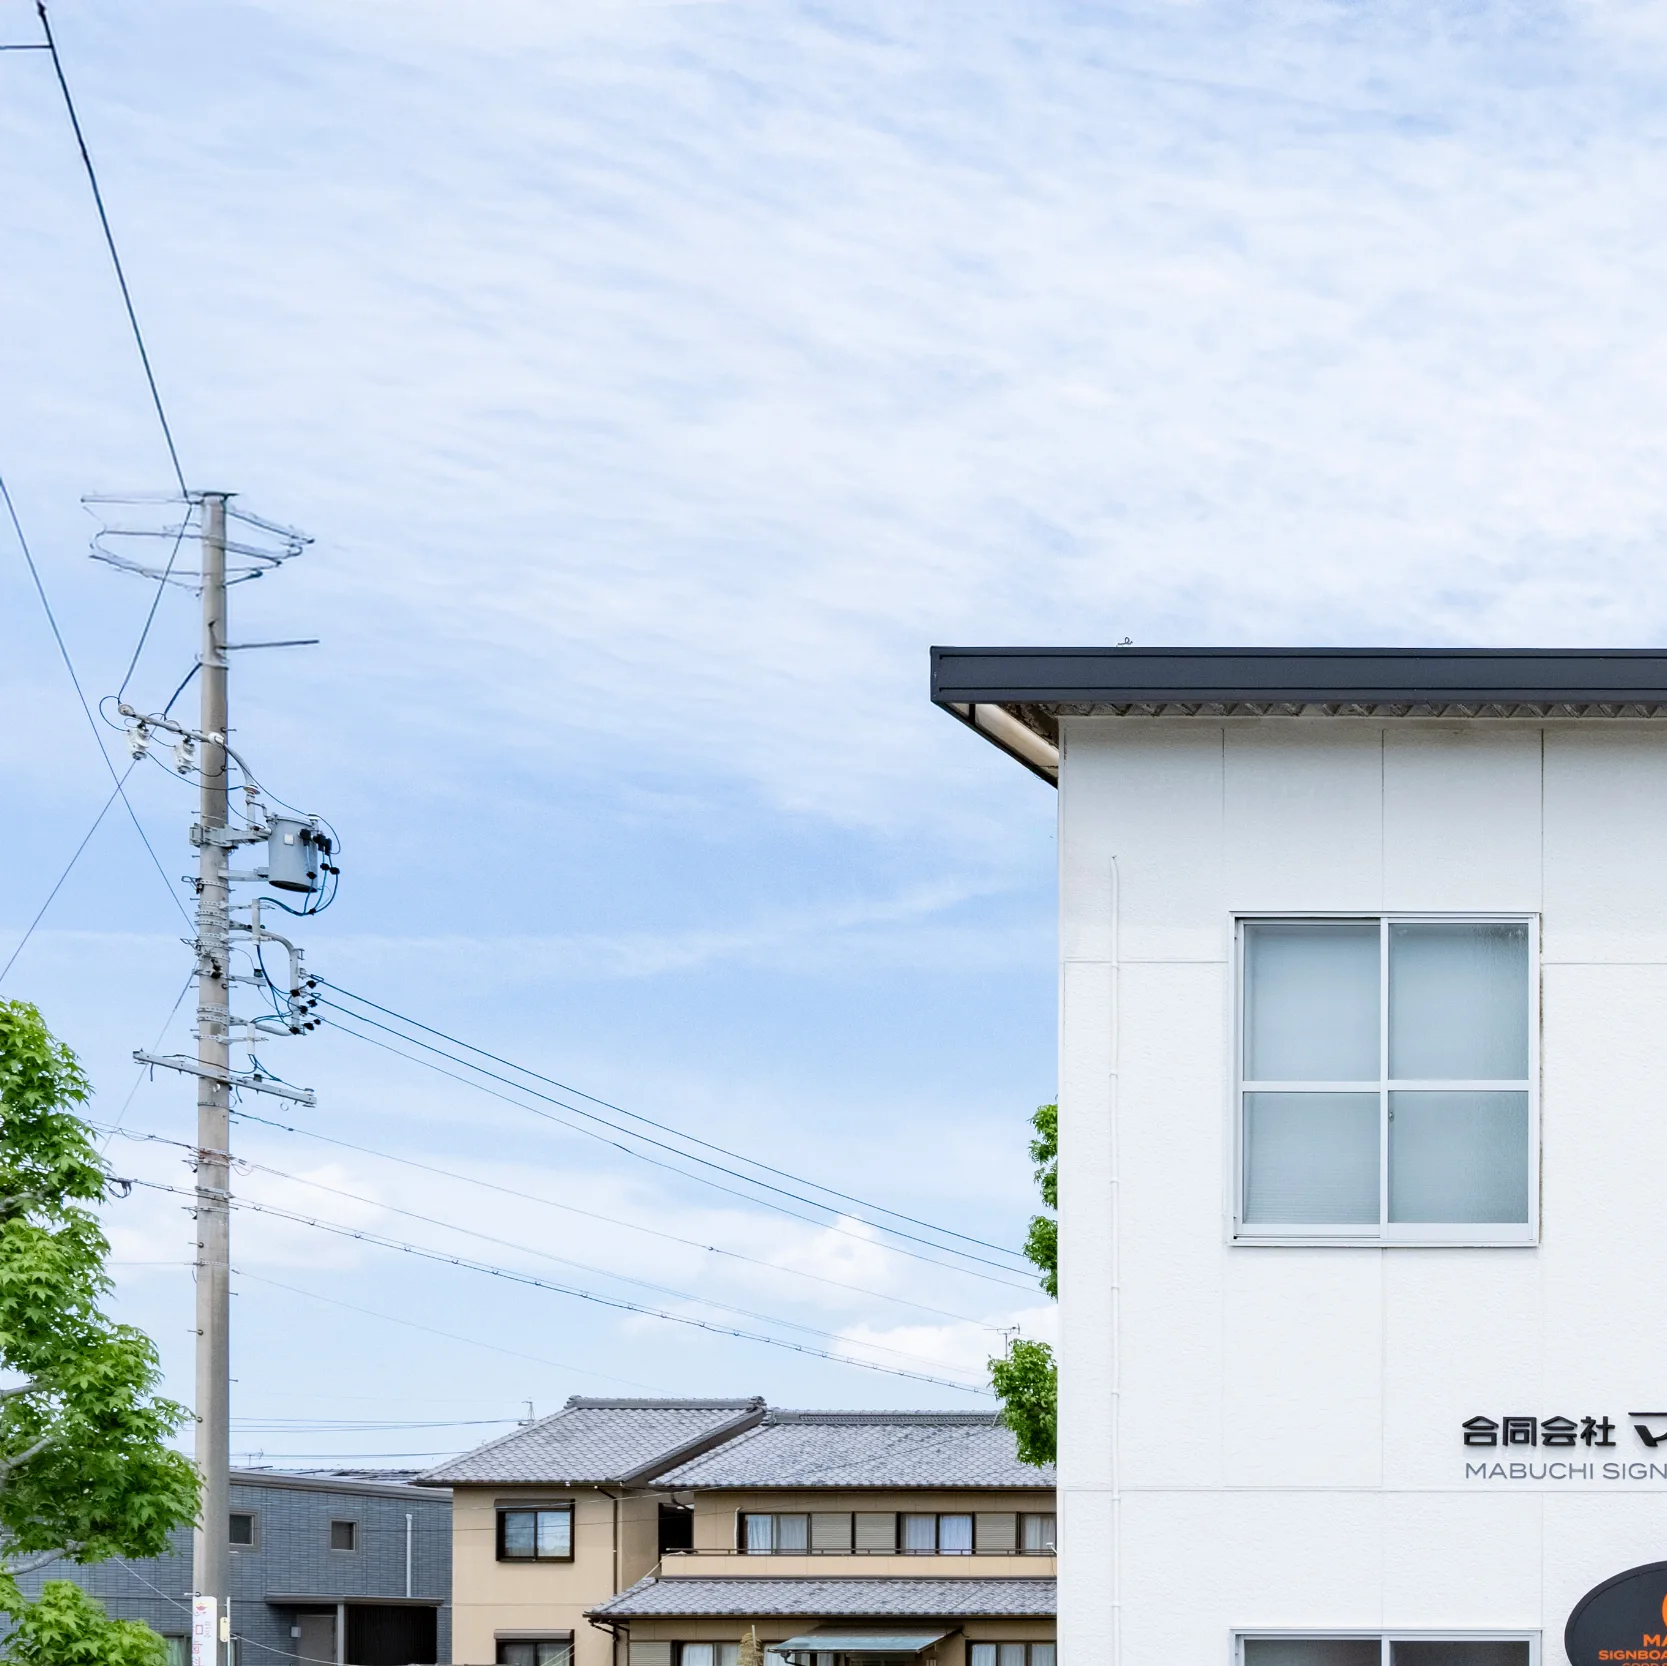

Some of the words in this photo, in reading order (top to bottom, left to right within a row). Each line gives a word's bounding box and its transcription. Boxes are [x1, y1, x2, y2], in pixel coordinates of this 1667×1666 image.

[1462, 1416, 1616, 1447] 合同会社
[1465, 1462, 1594, 1480] MABUCHI
